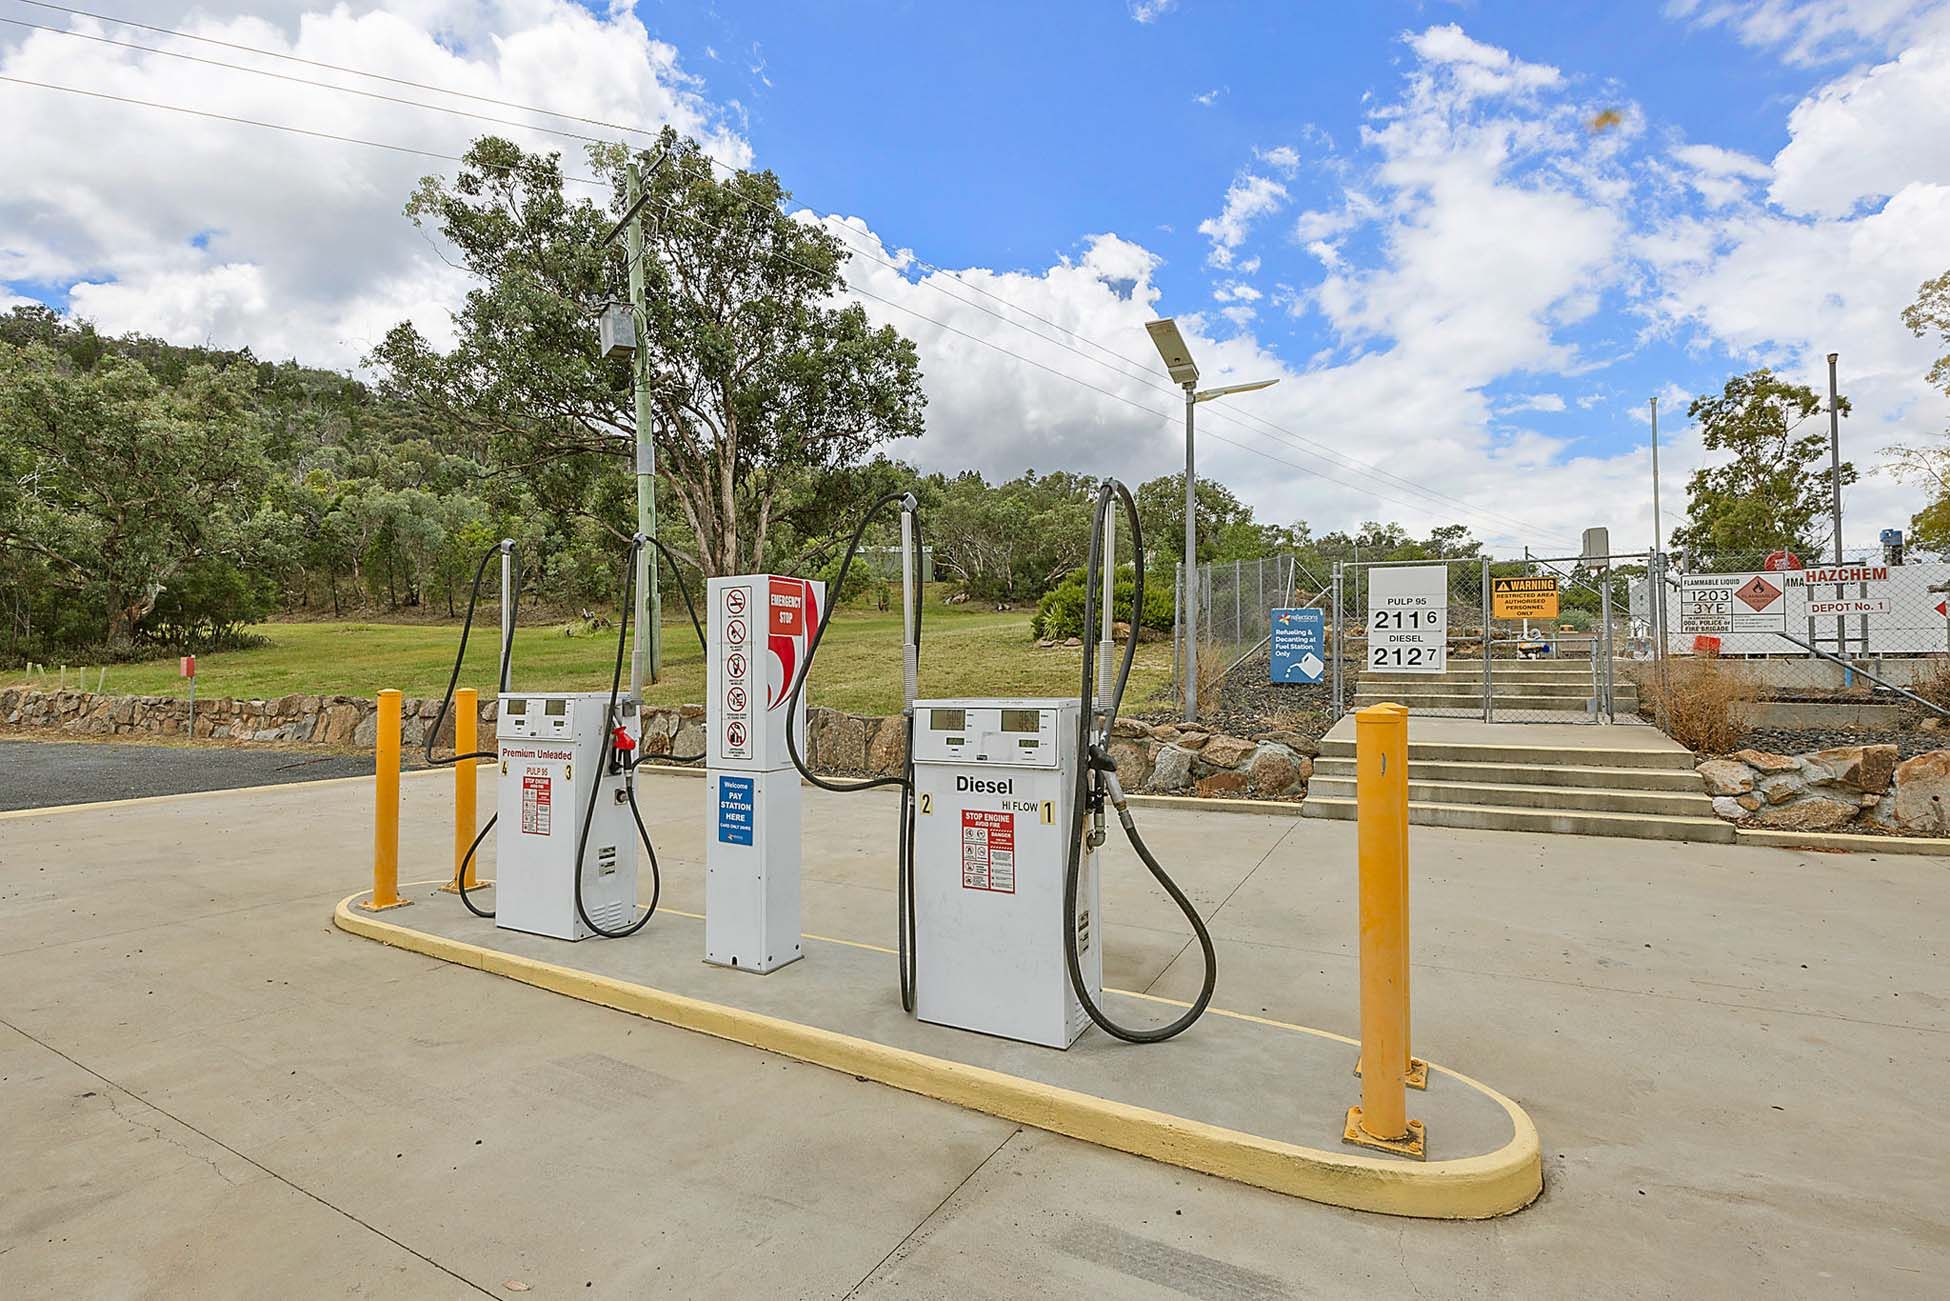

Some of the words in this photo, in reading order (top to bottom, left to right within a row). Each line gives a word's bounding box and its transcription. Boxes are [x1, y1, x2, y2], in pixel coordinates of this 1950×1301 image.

[1806, 567, 1887, 582] HAZCHEM
[1510, 580, 1554, 590] WARNING
[770, 593, 801, 608] EMERGENCY
[1691, 590, 1730, 601] 1203
[1387, 598, 1413, 606] PULP
[1415, 597, 1427, 606] 95
[1812, 603, 1852, 613] DEPOT
[1877, 601, 1884, 610] 1
[1694, 603, 1726, 614] 3YE
[779, 611, 793, 624] STOP
[1275, 629, 1307, 637] Refueling
[1389, 634, 1424, 643] DIESEL
[502, 747, 536, 757] Premium
[537, 749, 572, 760] Unleaded
[502, 761, 508, 776] 4
[526, 767, 541, 776] PULP
[541, 768, 549, 776] 95
[565, 764, 572, 780] 3
[723, 781, 748, 790] Welcome
[956, 775, 1013, 795] Diesel
[728, 791, 743, 800] PAY
[720, 801, 752, 811] STATION
[922, 794, 931, 814] 2
[1002, 801, 1011, 811] HI
[1013, 801, 1038, 812] FLOW
[725, 813, 746, 822] HERE
[965, 812, 983, 821] STOP
[984, 813, 1010, 823] ENGINE
[1043, 802, 1051, 823] 1
